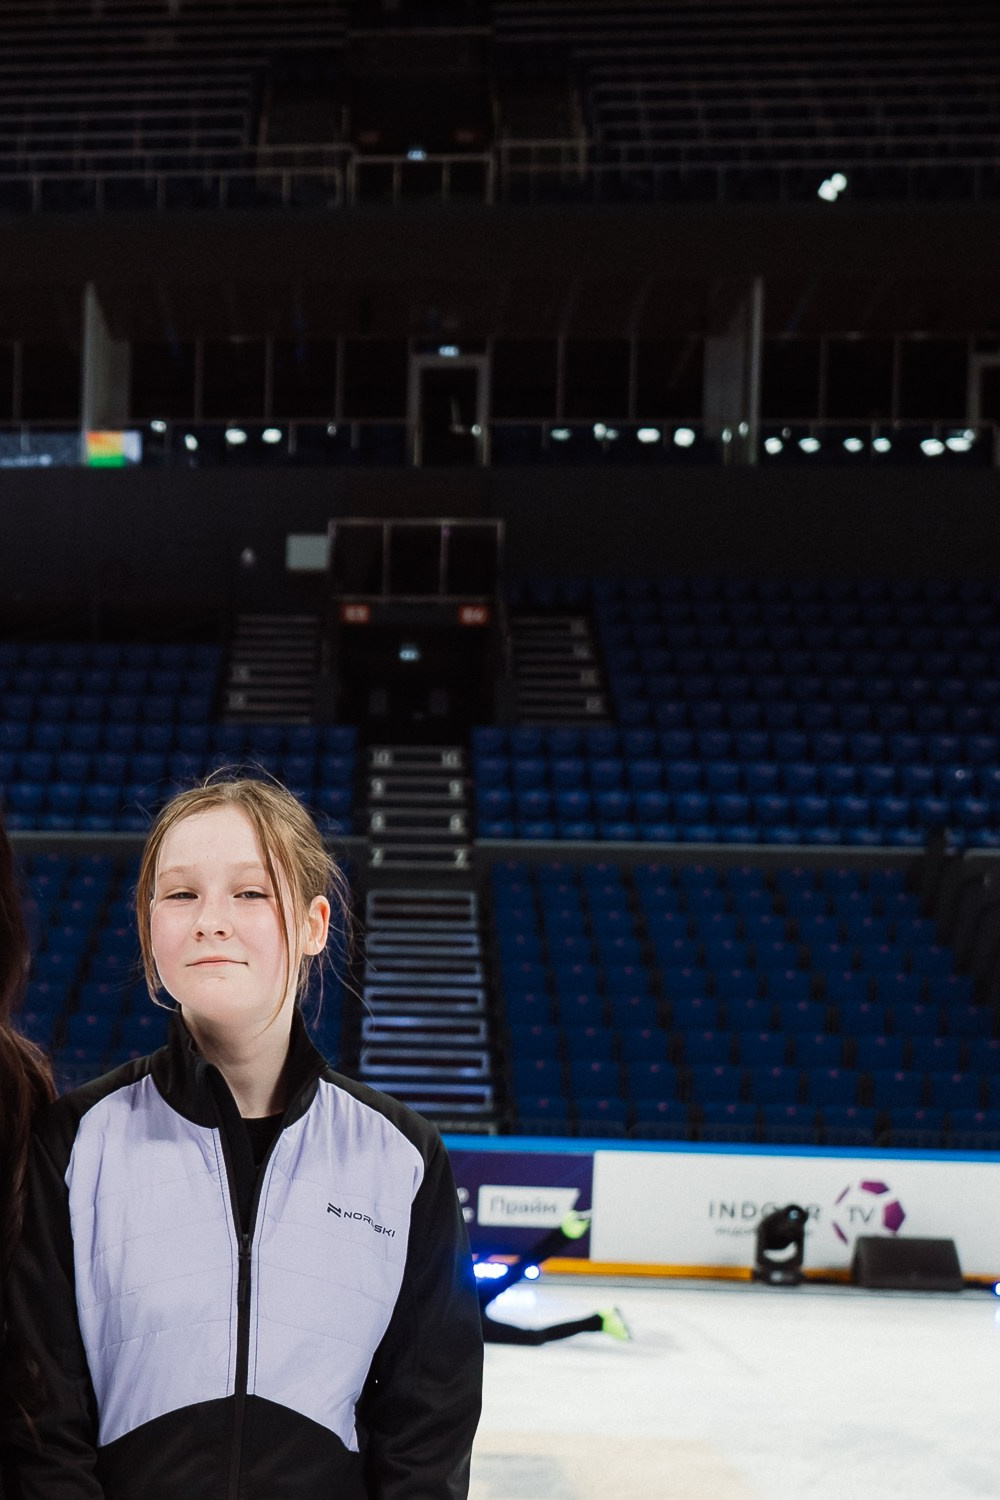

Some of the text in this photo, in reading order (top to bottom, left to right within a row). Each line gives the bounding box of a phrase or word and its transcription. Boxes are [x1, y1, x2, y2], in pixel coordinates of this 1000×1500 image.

[490, 1196, 556, 1214] Прайм
[709, 1202, 874, 1222] INDOR TV
[343, 1211, 395, 1237] NORSKI
